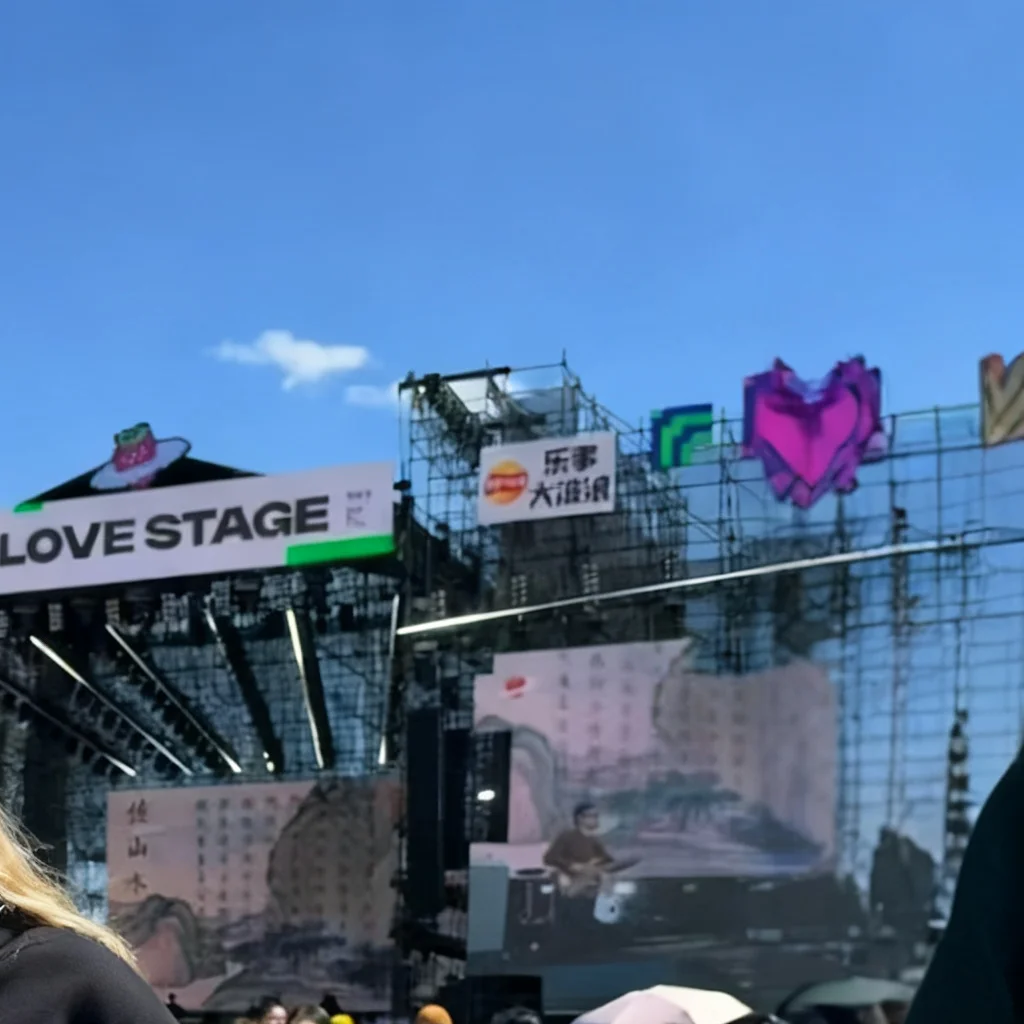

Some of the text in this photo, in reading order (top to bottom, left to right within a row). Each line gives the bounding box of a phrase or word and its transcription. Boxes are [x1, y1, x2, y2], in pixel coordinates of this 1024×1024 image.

[543, 445, 598, 476] 乐事
[0, 518, 136, 567] LOVE
[144, 496, 330, 551] STAGE
